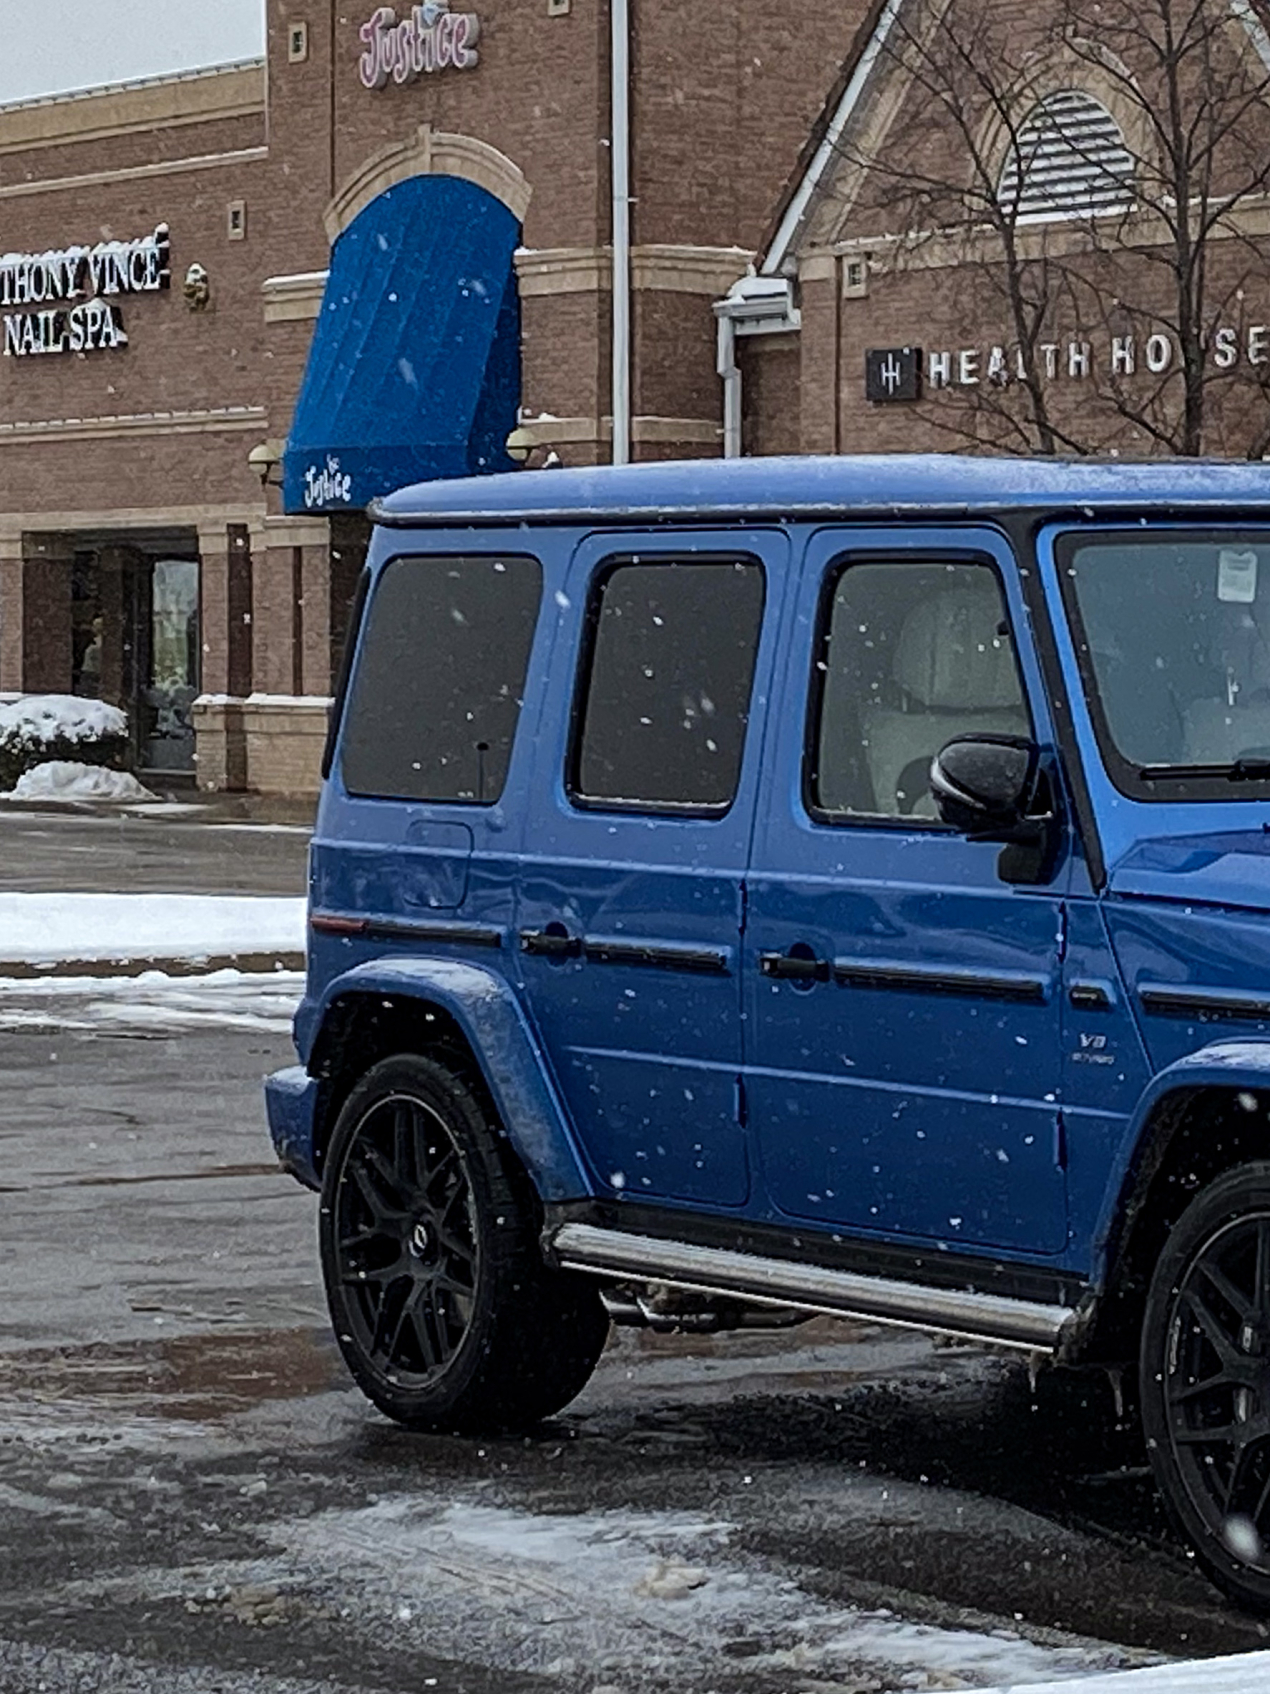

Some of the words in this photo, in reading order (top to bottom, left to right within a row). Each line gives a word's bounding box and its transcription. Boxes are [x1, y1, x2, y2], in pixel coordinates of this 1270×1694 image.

[359, 5, 479, 88] Justice
[88, 243, 161, 293] VINCE
[3, 311, 64, 355] NAIL
[69, 303, 118, 349] SPA
